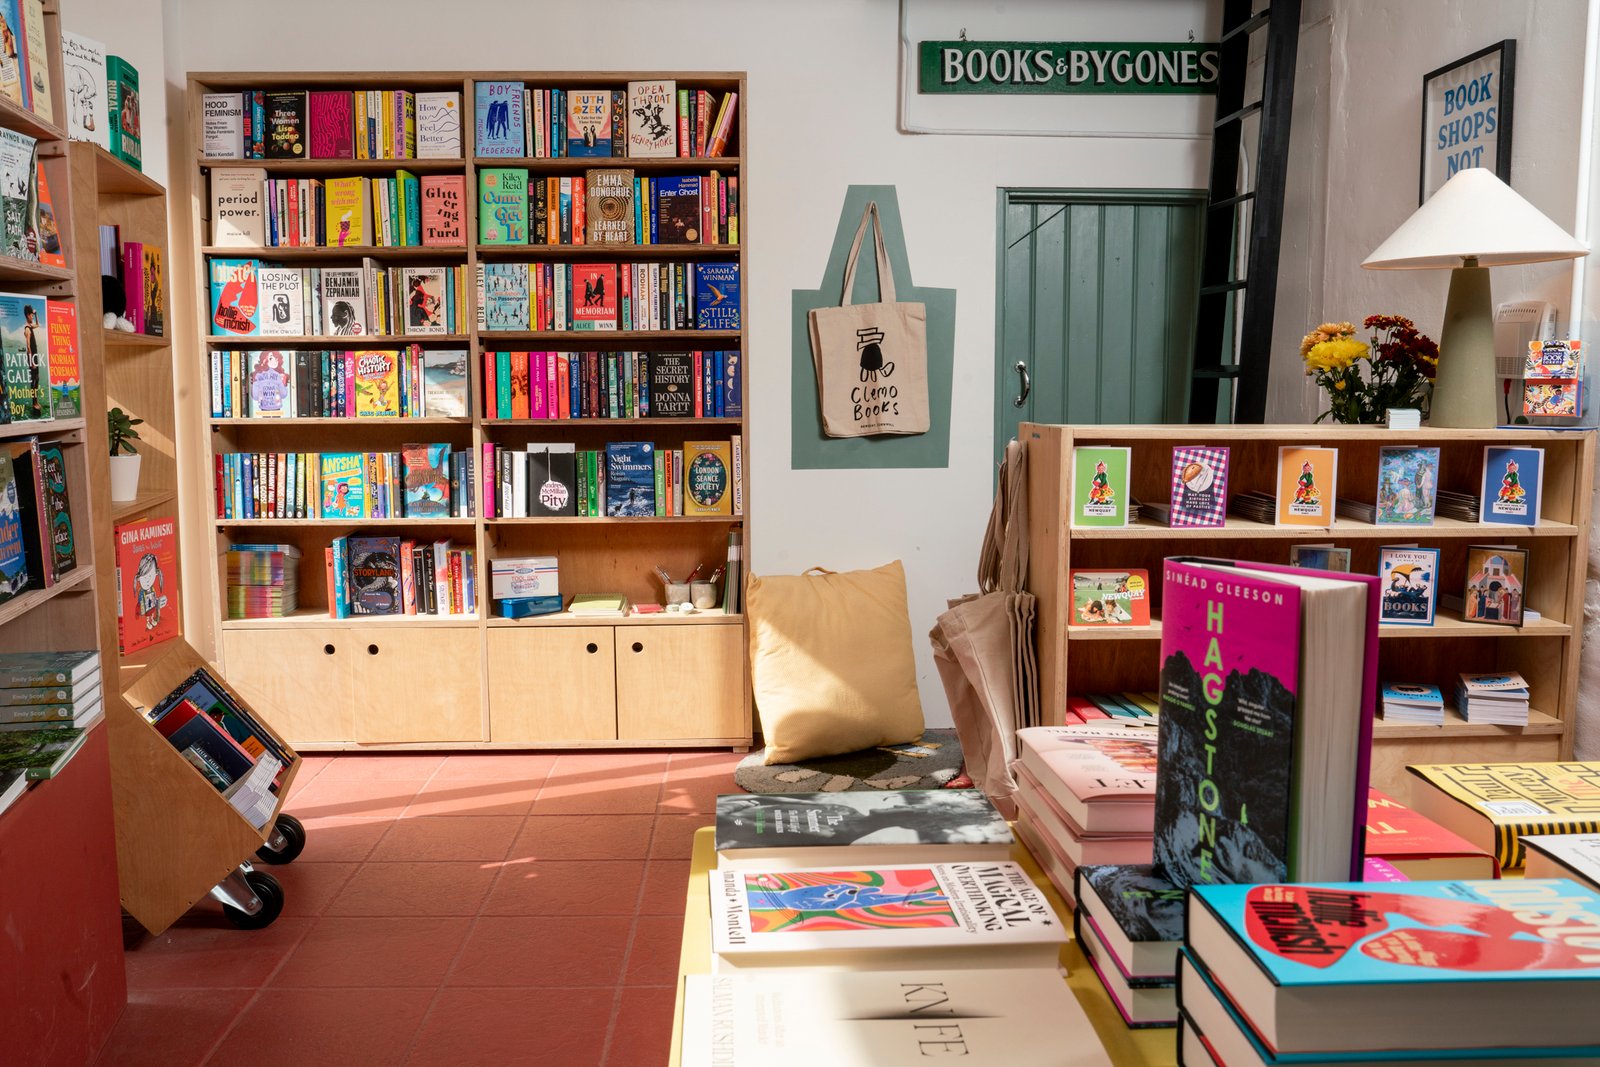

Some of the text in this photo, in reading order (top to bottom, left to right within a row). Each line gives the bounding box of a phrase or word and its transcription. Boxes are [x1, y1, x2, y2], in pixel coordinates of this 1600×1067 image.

[944, 49, 1218, 83] BOOKS & BYGONES
[489, 85, 511, 96] BOY
[638, 85, 664, 94] OPEN
[1444, 72, 1492, 116] BOOK
[108, 80, 118, 112] RURAL
[576, 96, 604, 104] RUTH
[632, 94, 670, 106] THROAT
[512, 88, 521, 128] FRIENDS
[573, 106, 606, 114] OZEKI
[1438, 106, 1496, 150] SHOPS
[631, 134, 673, 150] HENRY HOKE
[1447, 146, 1484, 181] NOT
[503, 173, 521, 181] Kiley
[598, 175, 622, 186] EMMA
[502, 181, 522, 190] Reid
[590, 186, 630, 197] DONOGHUE
[218, 192, 258, 207] period
[426, 188, 458, 199] Glitt
[484, 192, 522, 204] Come
[444, 200, 458, 209] er
[7, 210, 20, 222] SALT
[220, 209, 259, 220] power.
[495, 207, 523, 226] Get
[8, 223, 21, 236] PATH
[594, 221, 626, 230] LEARNED
[427, 228, 458, 238] Turd
[506, 223, 524, 241] It
[593, 231, 628, 241] BY HEART
[325, 278, 359, 287] BENJAMIN
[326, 288, 360, 297] ZEPHANIAH
[218, 303, 238, 320] hollie
[704, 308, 735, 317] STILL
[50, 323, 70, 334] FUNNY
[707, 320, 731, 328] LIFE
[52, 336, 70, 346] THING
[5, 352, 46, 369] PATRICK
[50, 354, 76, 365] NORMAN
[358, 355, 386, 368] CHAOTIC
[50, 367, 77, 376] FOREMAN
[358, 361, 391, 375] HISTORY
[656, 366, 688, 374] SECRET
[7, 369, 32, 384] GALE
[655, 375, 690, 384] HISTORY
[9, 385, 44, 400] Mother's
[655, 393, 691, 402] DONNA
[851, 385, 898, 404] Clemo
[10, 402, 25, 417] Boy
[656, 402, 690, 411] TARTT
[260, 458, 266, 466] OH
[485, 452, 493, 483] WAHALA
[696, 474, 718, 482] SÉANCE
[55, 499, 64, 510] the
[542, 495, 566, 508] Pity
[122, 522, 173, 545] GINA KAMINSKI
[354, 568, 395, 576] STORYLAND
[1166, 570, 1283, 606] SINÉAD GLEESON
[1102, 589, 1145, 600] NEWQUAY
[1384, 601, 1428, 612] BOOKS
[1199, 600, 1224, 881] HAGSTONE
[1460, 779, 1521, 800] Paul
[1500, 770, 1578, 805] Murray
[951, 865, 1002, 931] OVERTHINKING
[1006, 872, 1048, 915] THE AGE OF
[1306, 891, 1381, 928] hollie
[727, 905, 746, 944] Montell
[1462, 879, 1600, 963] lobst
[1249, 901, 1346, 954] mcnish
[900, 982, 969, 1056] KNIFE
